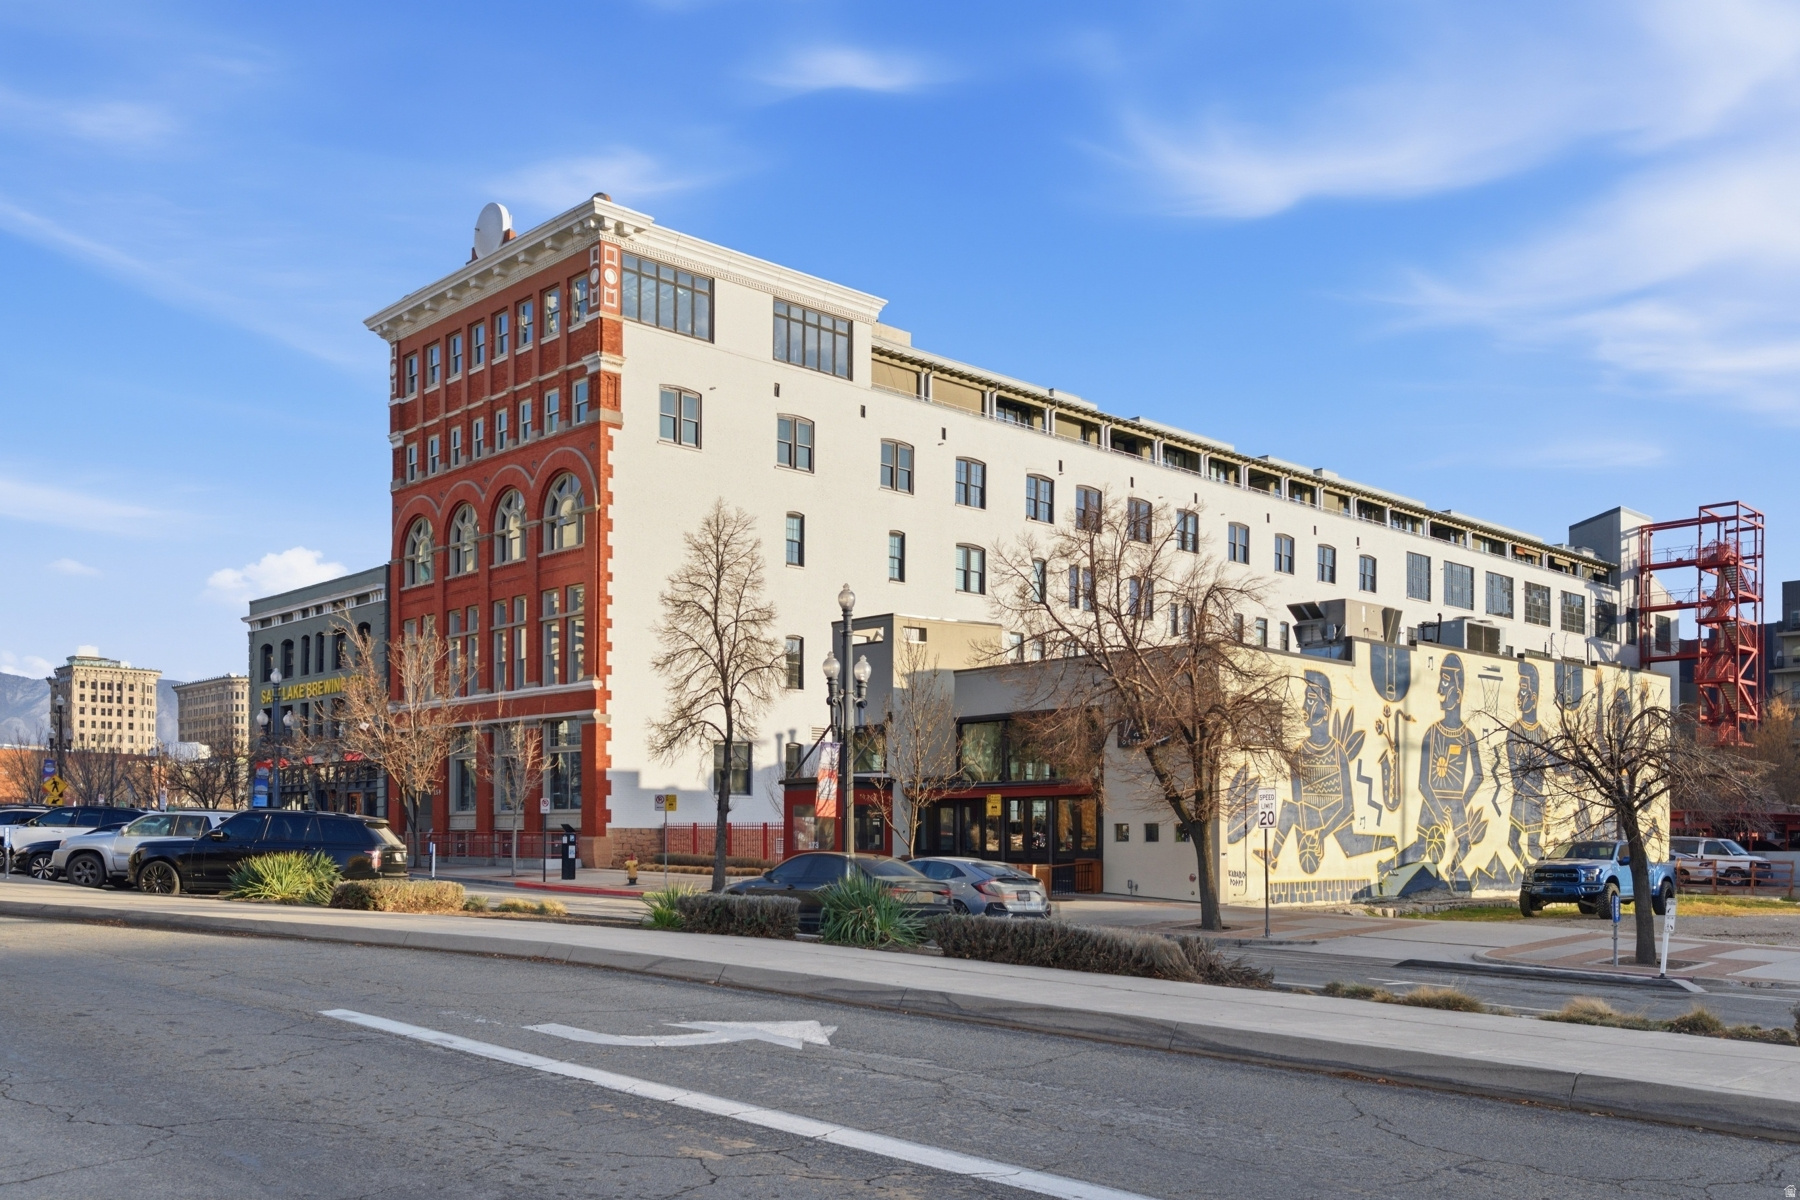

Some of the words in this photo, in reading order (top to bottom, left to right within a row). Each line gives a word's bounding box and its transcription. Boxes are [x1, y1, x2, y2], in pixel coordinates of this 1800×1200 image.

[283, 681, 305, 700] LAKE
[306, 676, 346, 697] BREWING
[1260, 811, 1275, 825] 20
[808, 841, 820, 849] 173
